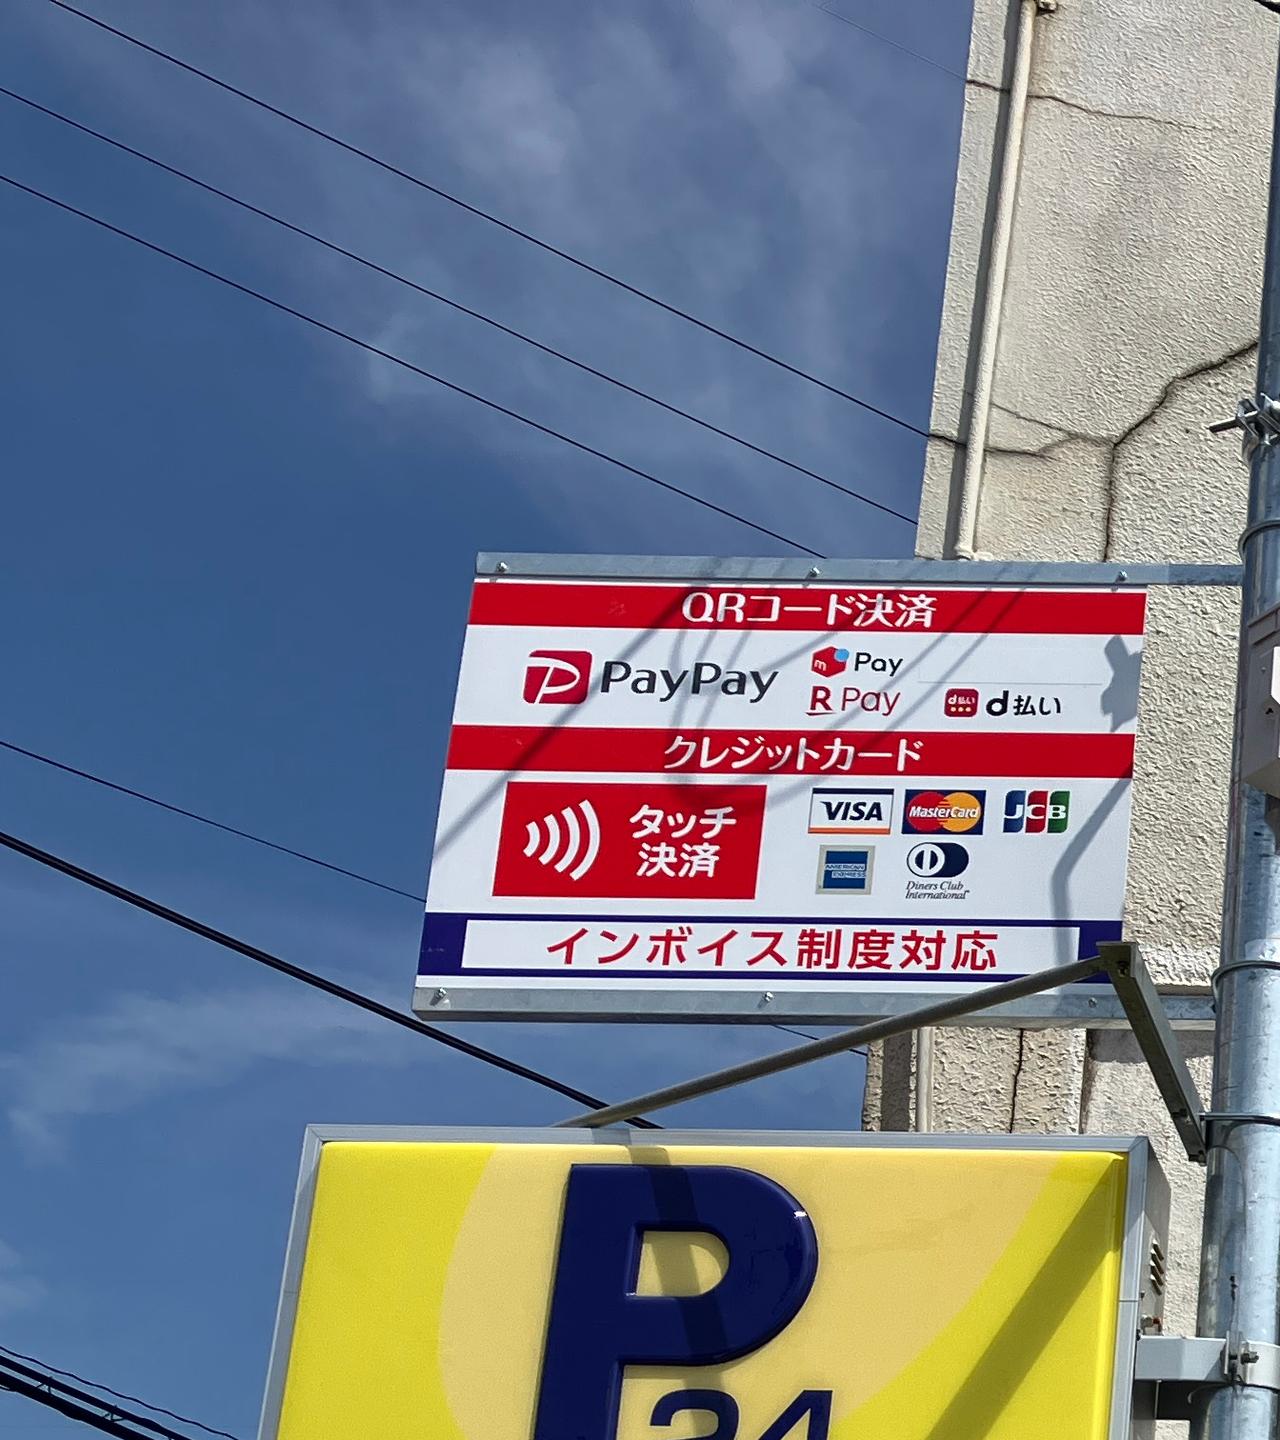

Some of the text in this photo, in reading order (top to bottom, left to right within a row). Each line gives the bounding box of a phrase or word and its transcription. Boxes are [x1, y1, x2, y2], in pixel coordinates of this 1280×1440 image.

[681, 591, 938, 629] QRコード決済
[854, 652, 903, 677] Pay
[601, 661, 779, 703] PayPay
[841, 687, 901, 717] Pay
[986, 690, 1062, 717] d払い
[663, 735, 924, 773] クレジットカード
[630, 803, 737, 837] タッチ
[820, 801, 884, 822] VISA
[909, 805, 980, 819] MasterCard
[1003, 804, 1067, 820] JCB
[637, 843, 720, 878] 決済
[906, 880, 964, 891] Diners Club
[546, 927, 999, 972] インボイス制度対応
